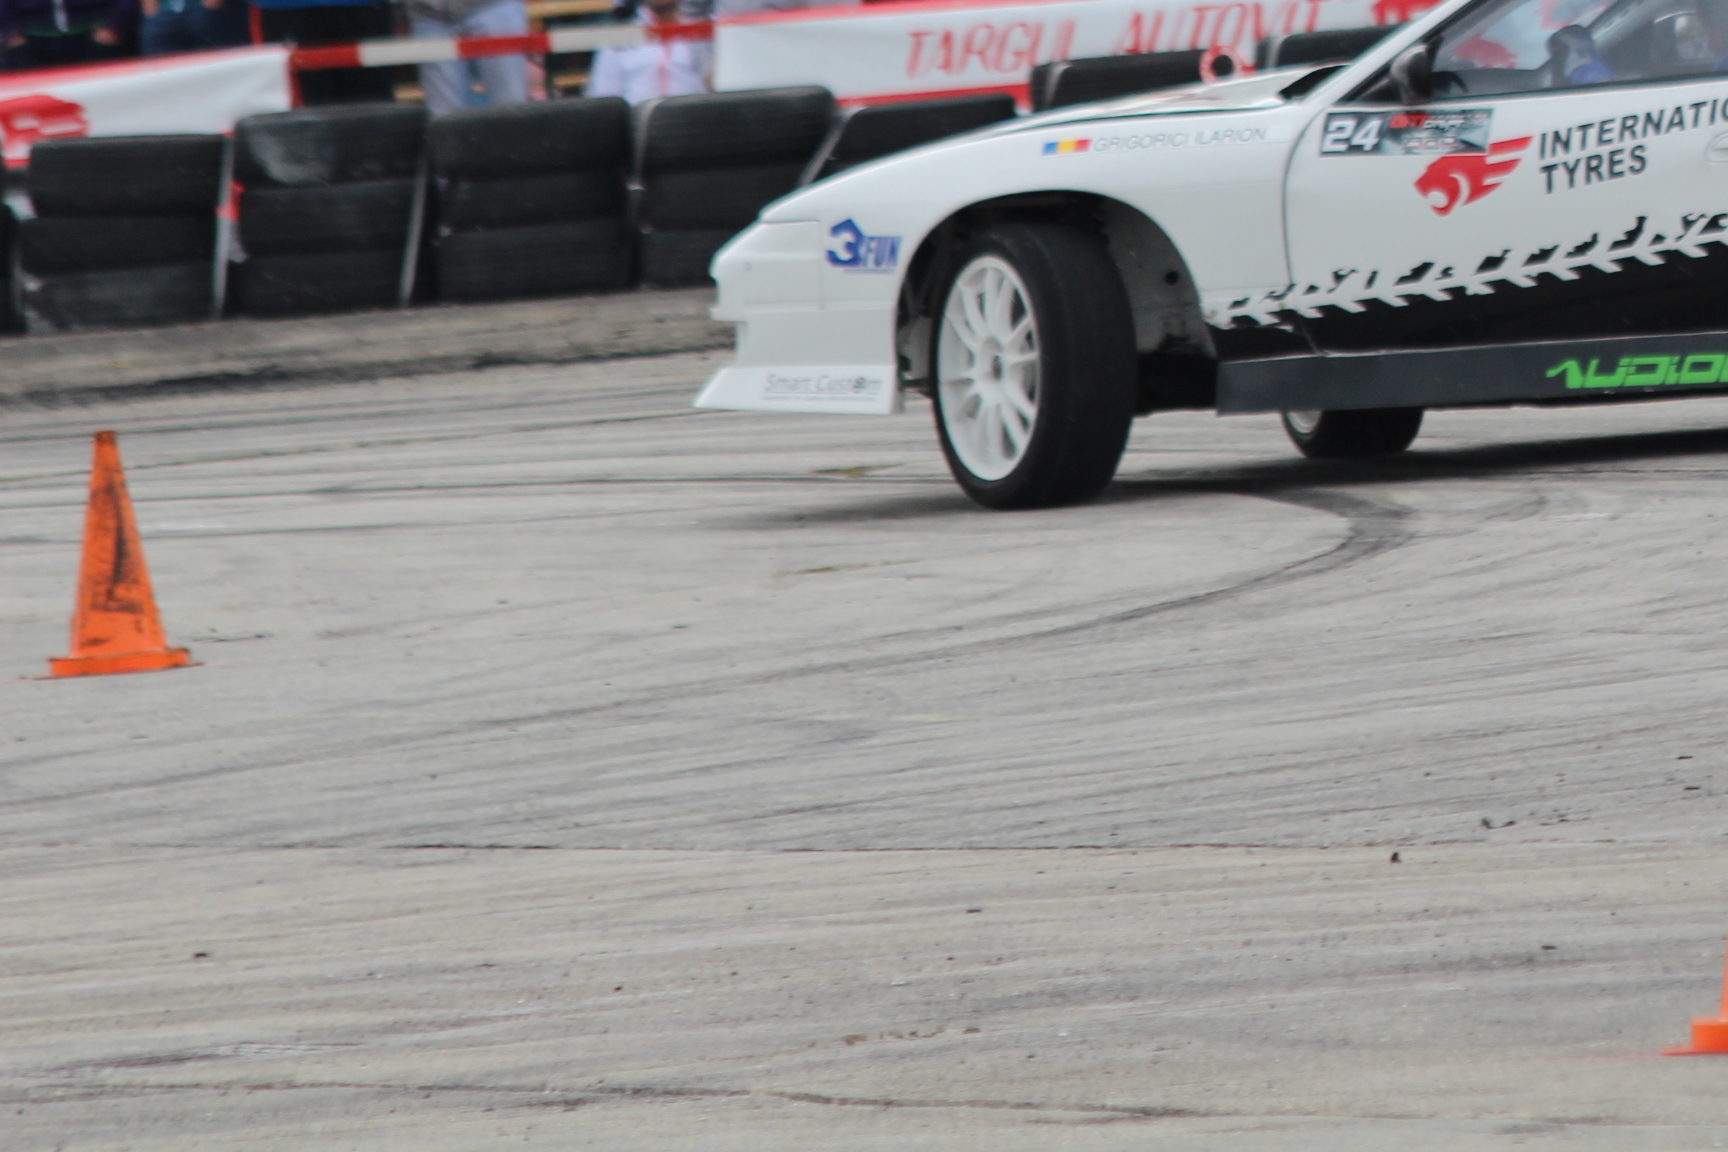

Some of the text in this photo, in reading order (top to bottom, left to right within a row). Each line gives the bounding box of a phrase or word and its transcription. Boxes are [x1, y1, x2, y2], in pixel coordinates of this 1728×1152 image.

[906, 19, 1075, 77] TARGUL
[1321, 119, 1384, 153] 24
[1539, 144, 1648, 195] TYRES
